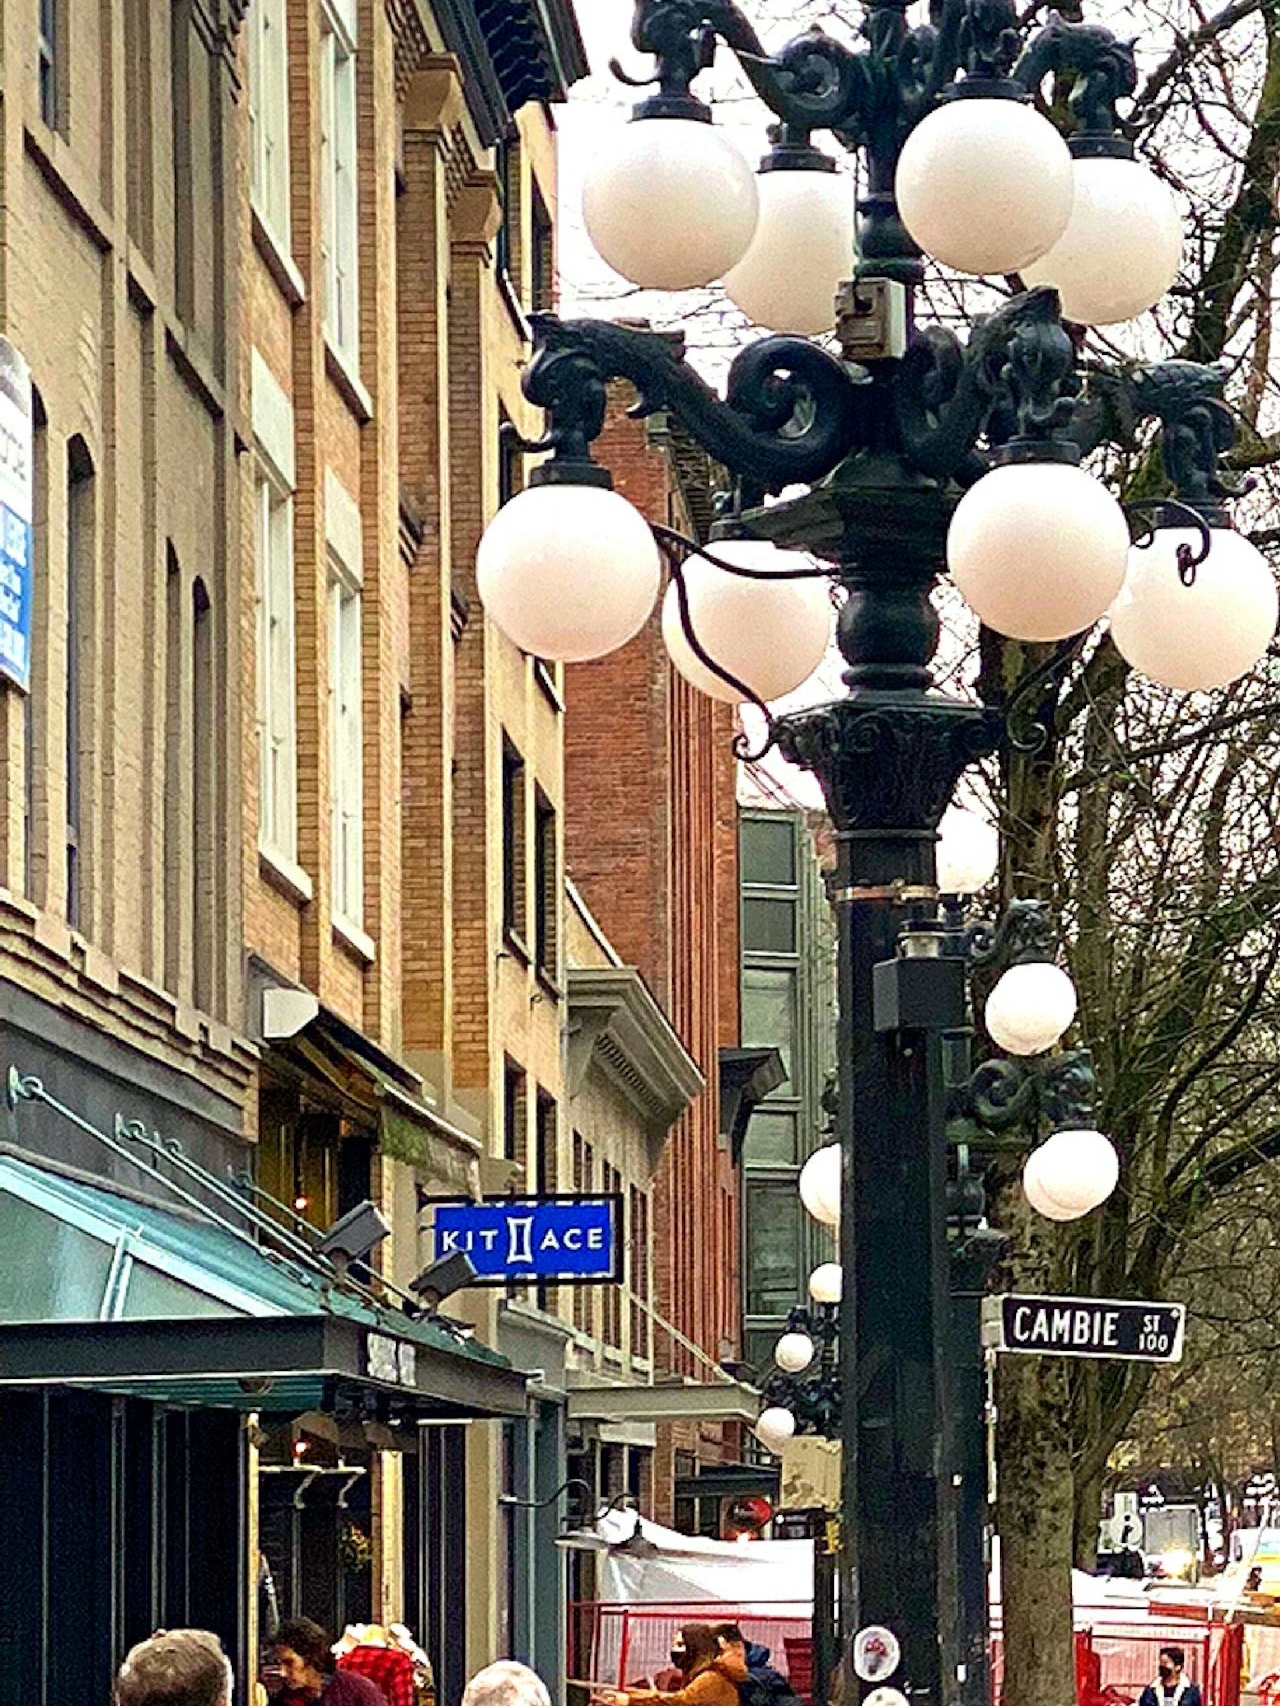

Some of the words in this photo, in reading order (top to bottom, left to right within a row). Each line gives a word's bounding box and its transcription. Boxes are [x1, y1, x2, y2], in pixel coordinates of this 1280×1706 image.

[442, 1228, 499, 1251] KIT
[540, 1227, 603, 1251] ACE
[1013, 1305, 1119, 1346] CAMBIE
[1142, 1314, 1162, 1333] ST
[1139, 1333, 1169, 1352] 100
